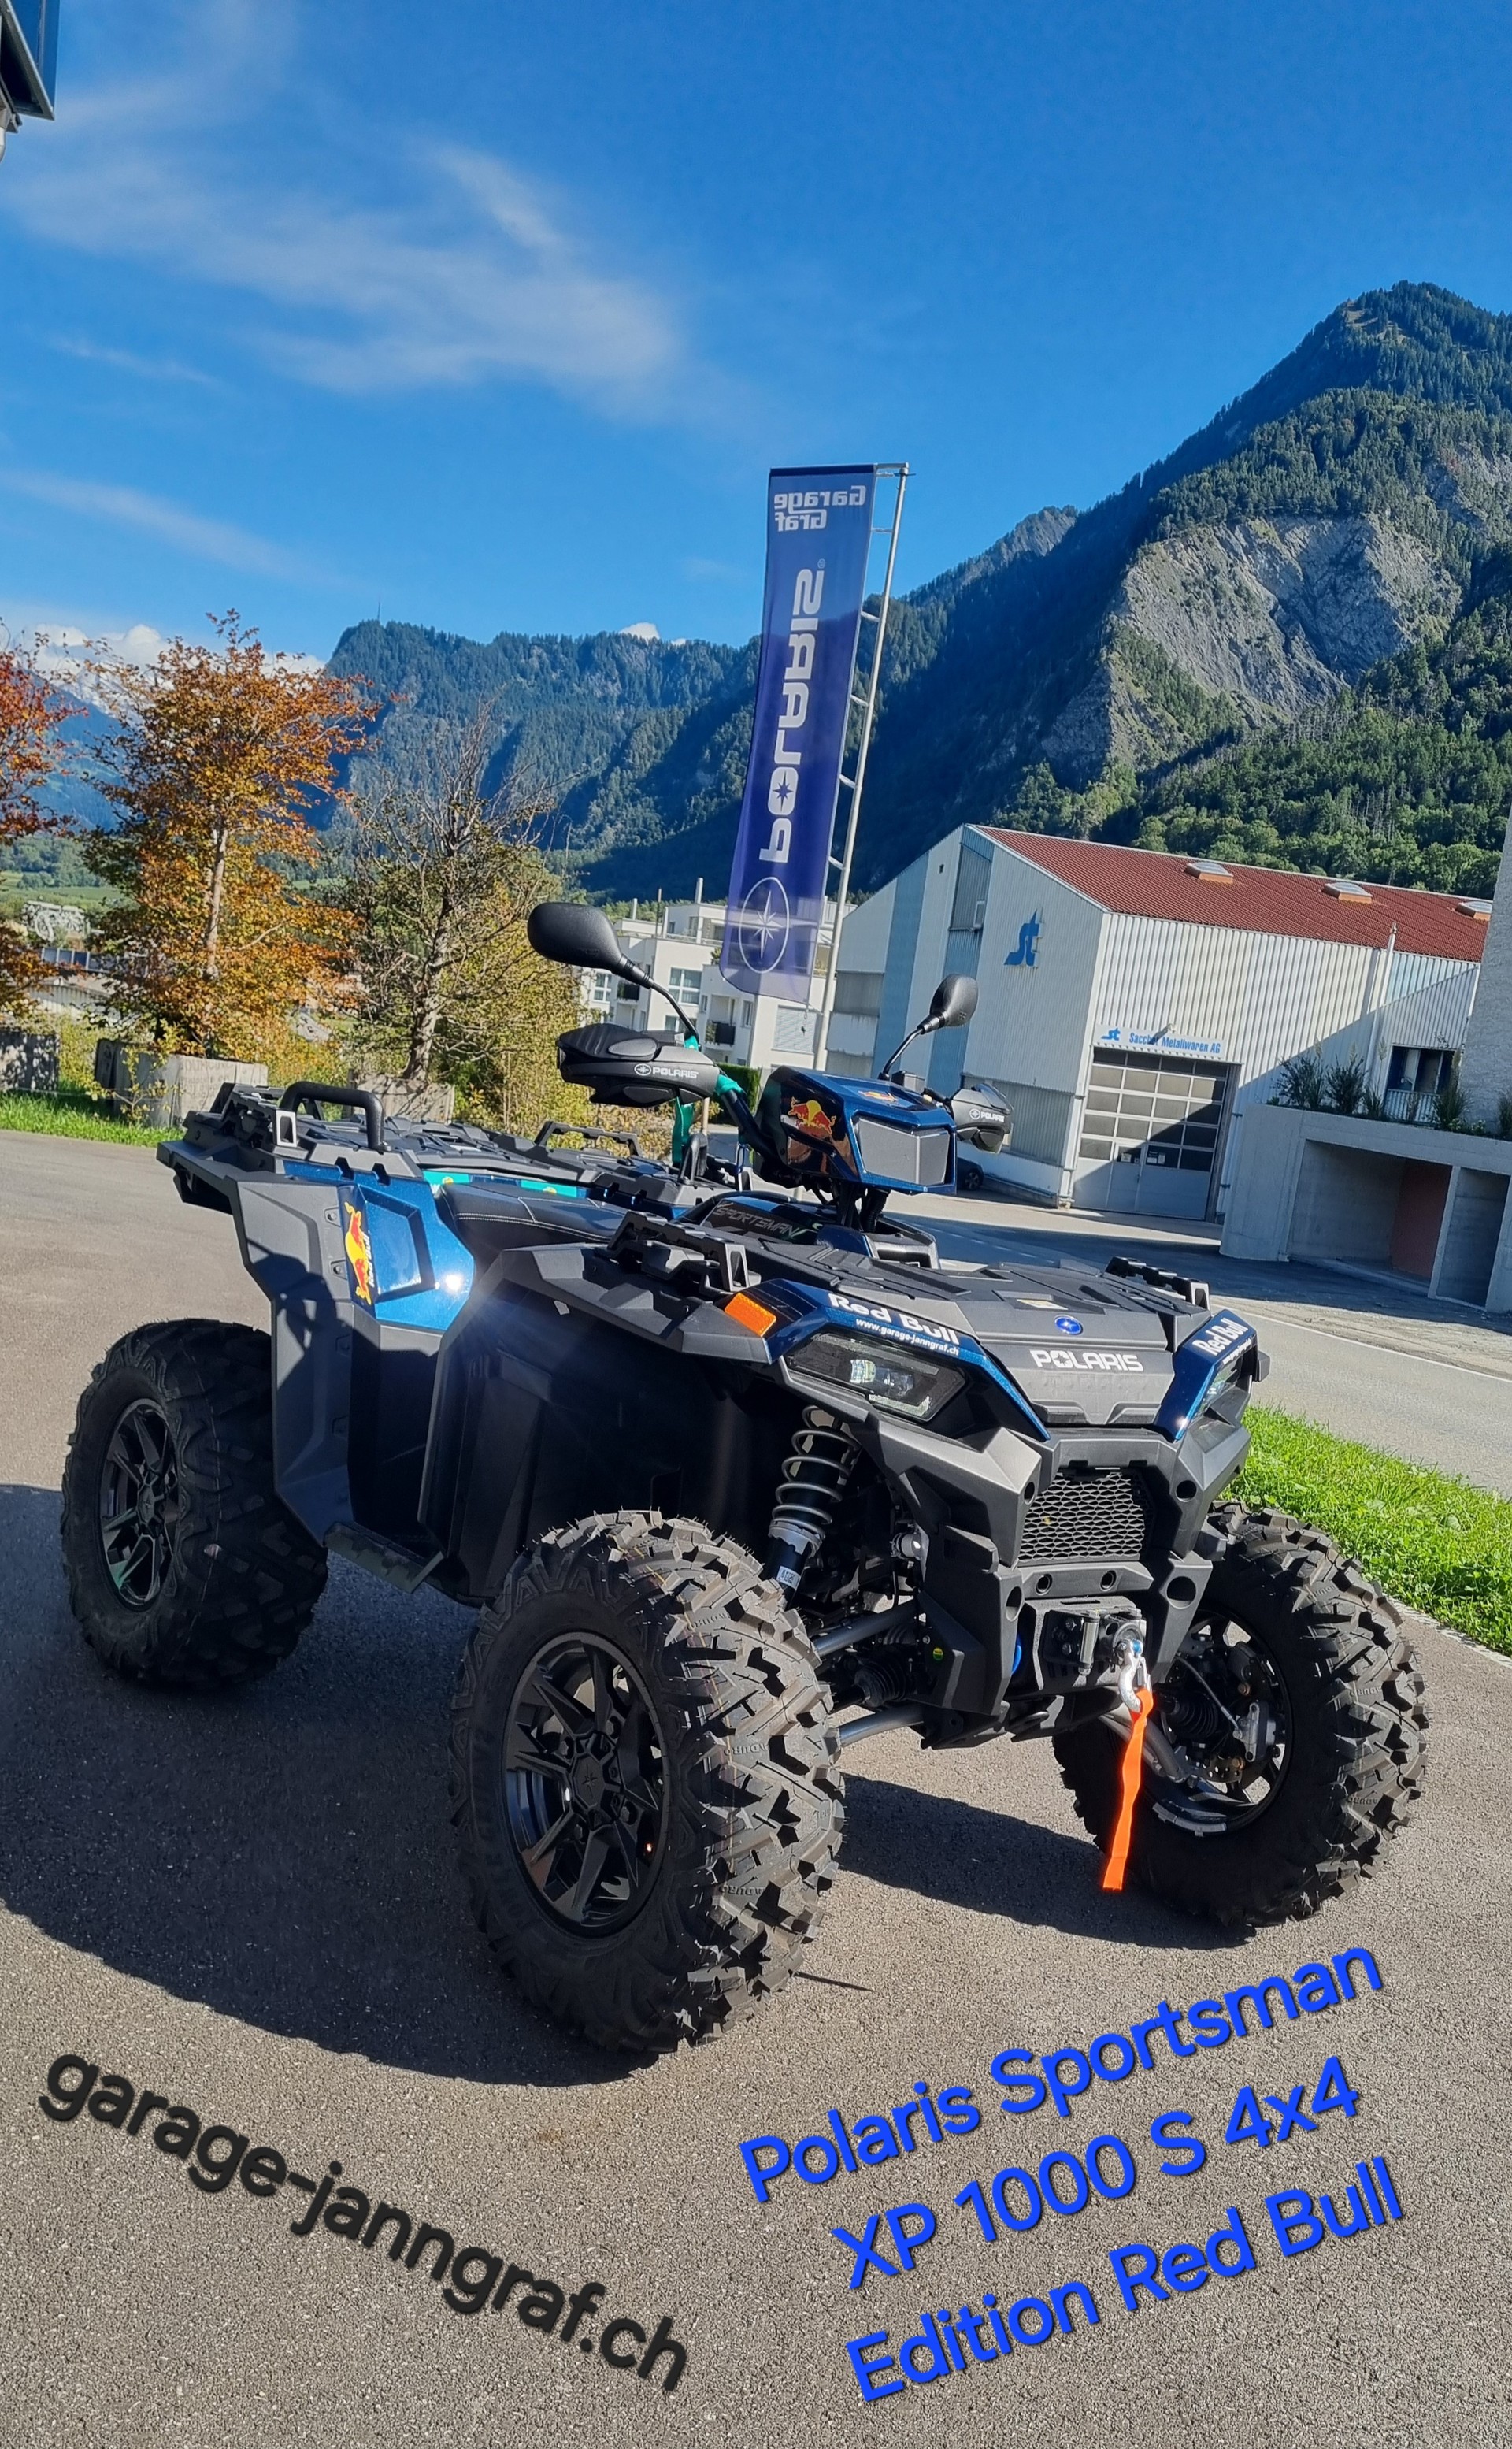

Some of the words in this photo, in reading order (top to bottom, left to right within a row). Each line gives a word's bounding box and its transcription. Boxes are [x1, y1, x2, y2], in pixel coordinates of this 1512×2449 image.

[1162, 1036, 1208, 1052] Metallwaren
[1210, 1042, 1221, 1054] AG
[652, 1067, 699, 1079] POLARIS
[980, 1111, 1005, 1122] POLARIS
[713, 1207, 799, 1237] SPORTSMAN
[828, 1293, 892, 1323] Red
[899, 1314, 960, 1345] Bull
[856, 1319, 959, 1356] www.garage-janngraf.ch
[1191, 1330, 1232, 1356] Red
[1212, 1317, 1249, 1341] Bull
[1029, 1349, 1144, 1372] POLARIS
[724, 1743, 761, 1757] DURO
